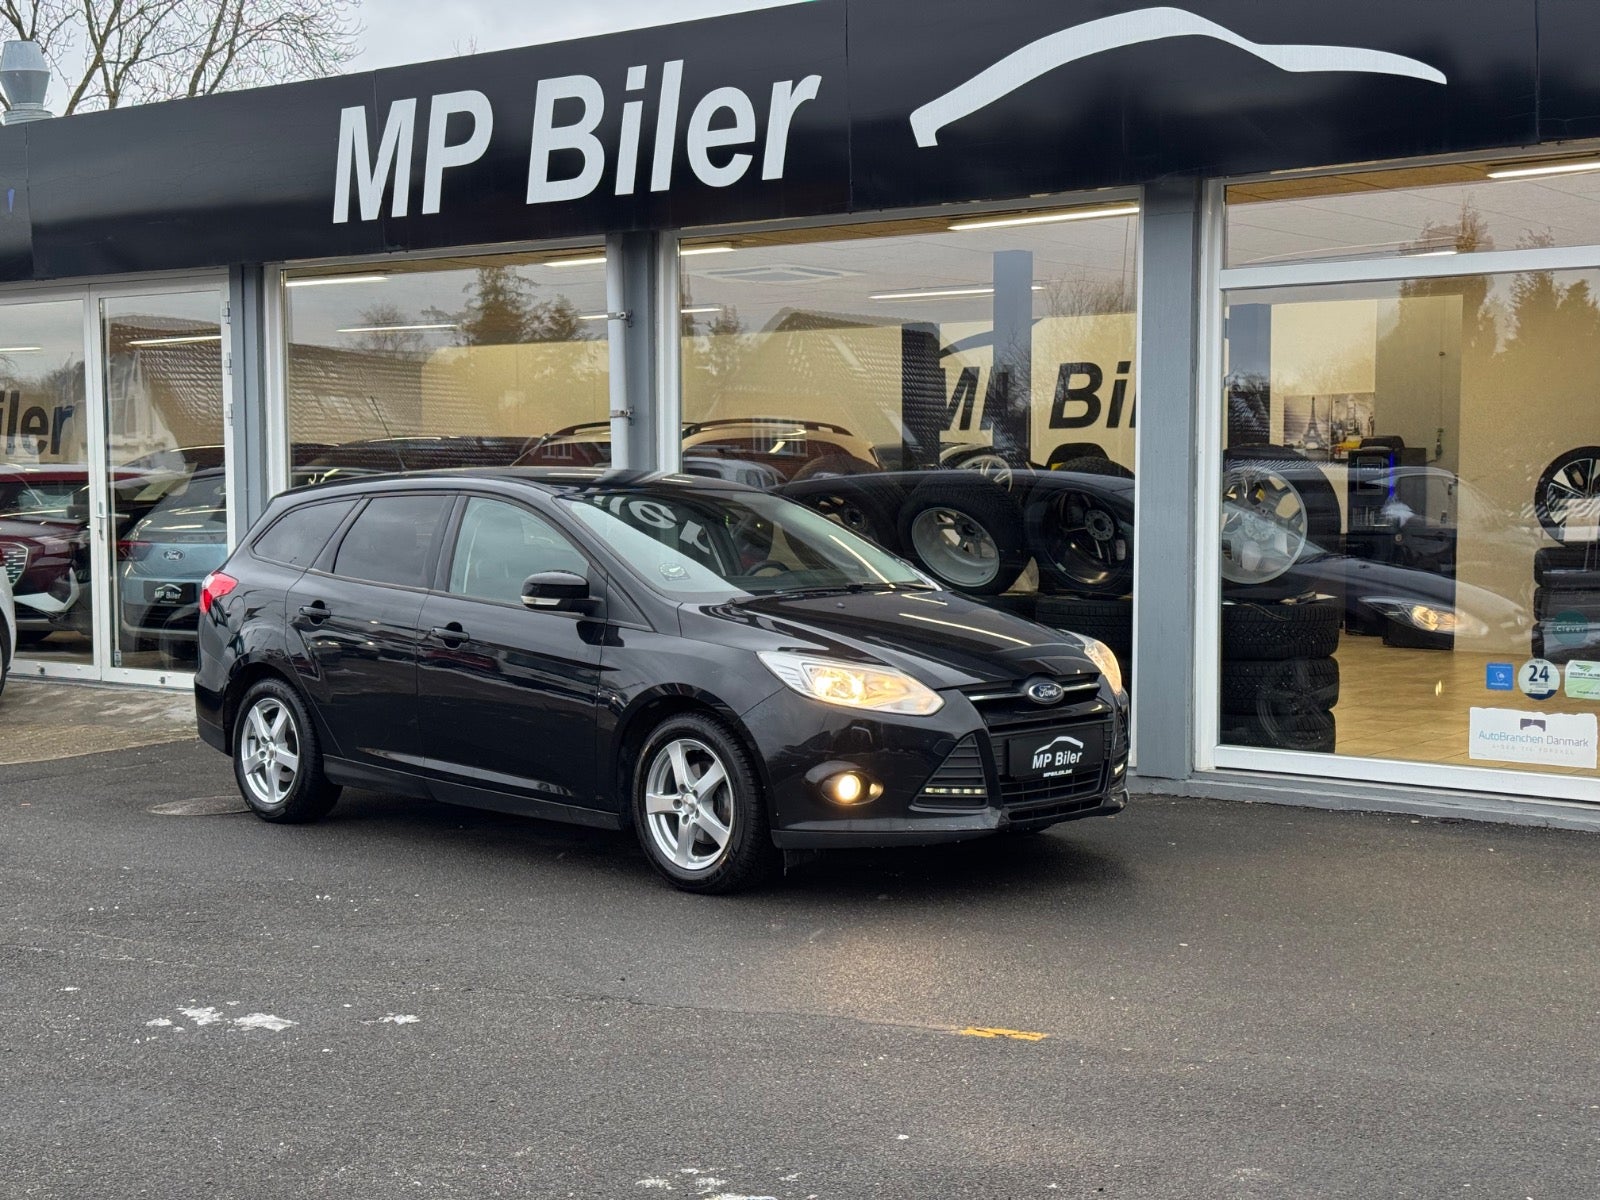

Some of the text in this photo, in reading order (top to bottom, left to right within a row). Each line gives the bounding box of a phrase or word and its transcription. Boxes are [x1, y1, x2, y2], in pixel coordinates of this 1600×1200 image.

[333, 59, 822, 224] MP Biler
[1528, 664, 1550, 682] 24
[1478, 730, 1589, 748] AutoBranchen Danmark
[1032, 750, 1083, 769] MP Biler
